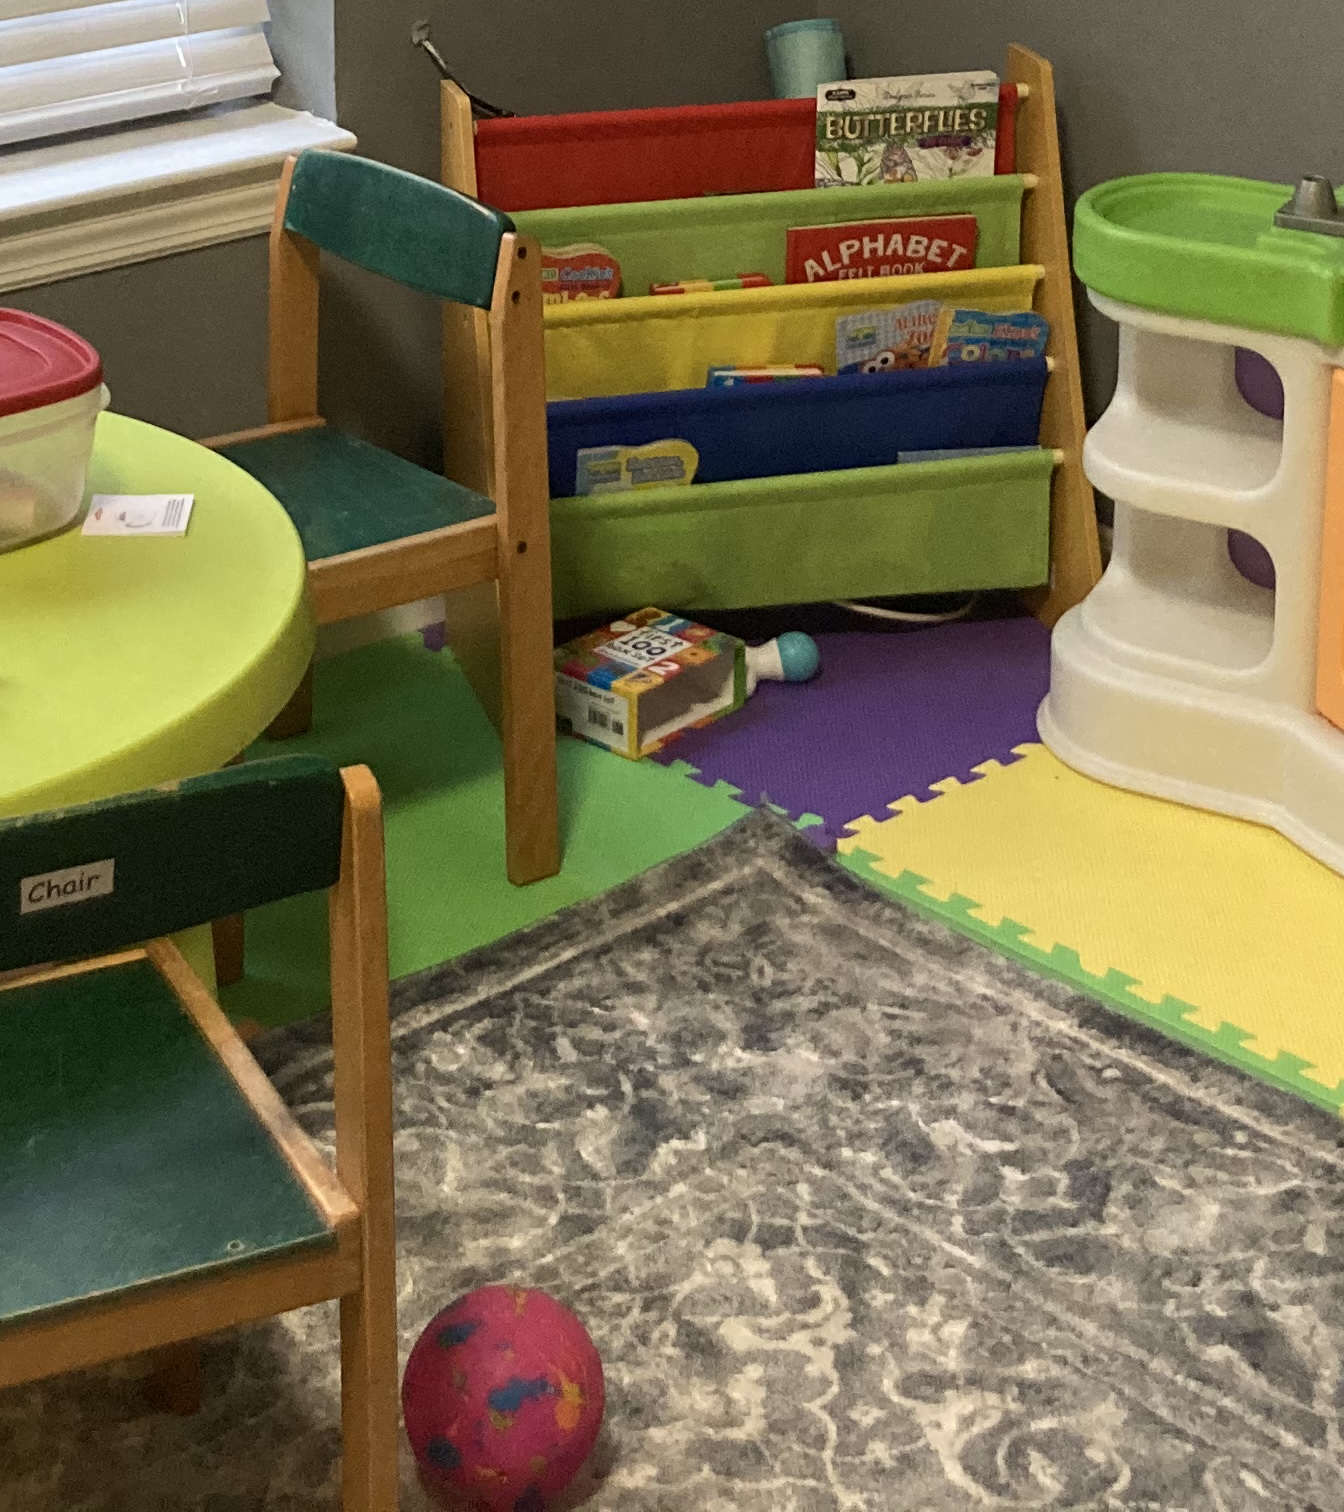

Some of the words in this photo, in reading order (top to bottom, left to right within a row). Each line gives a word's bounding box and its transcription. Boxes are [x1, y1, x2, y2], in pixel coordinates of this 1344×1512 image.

[826, 108, 987, 139] BUTTERFLIES
[804, 233, 968, 283] ALPHABET
[620, 636, 667, 656] 100
[28, 872, 101, 904] Chair
